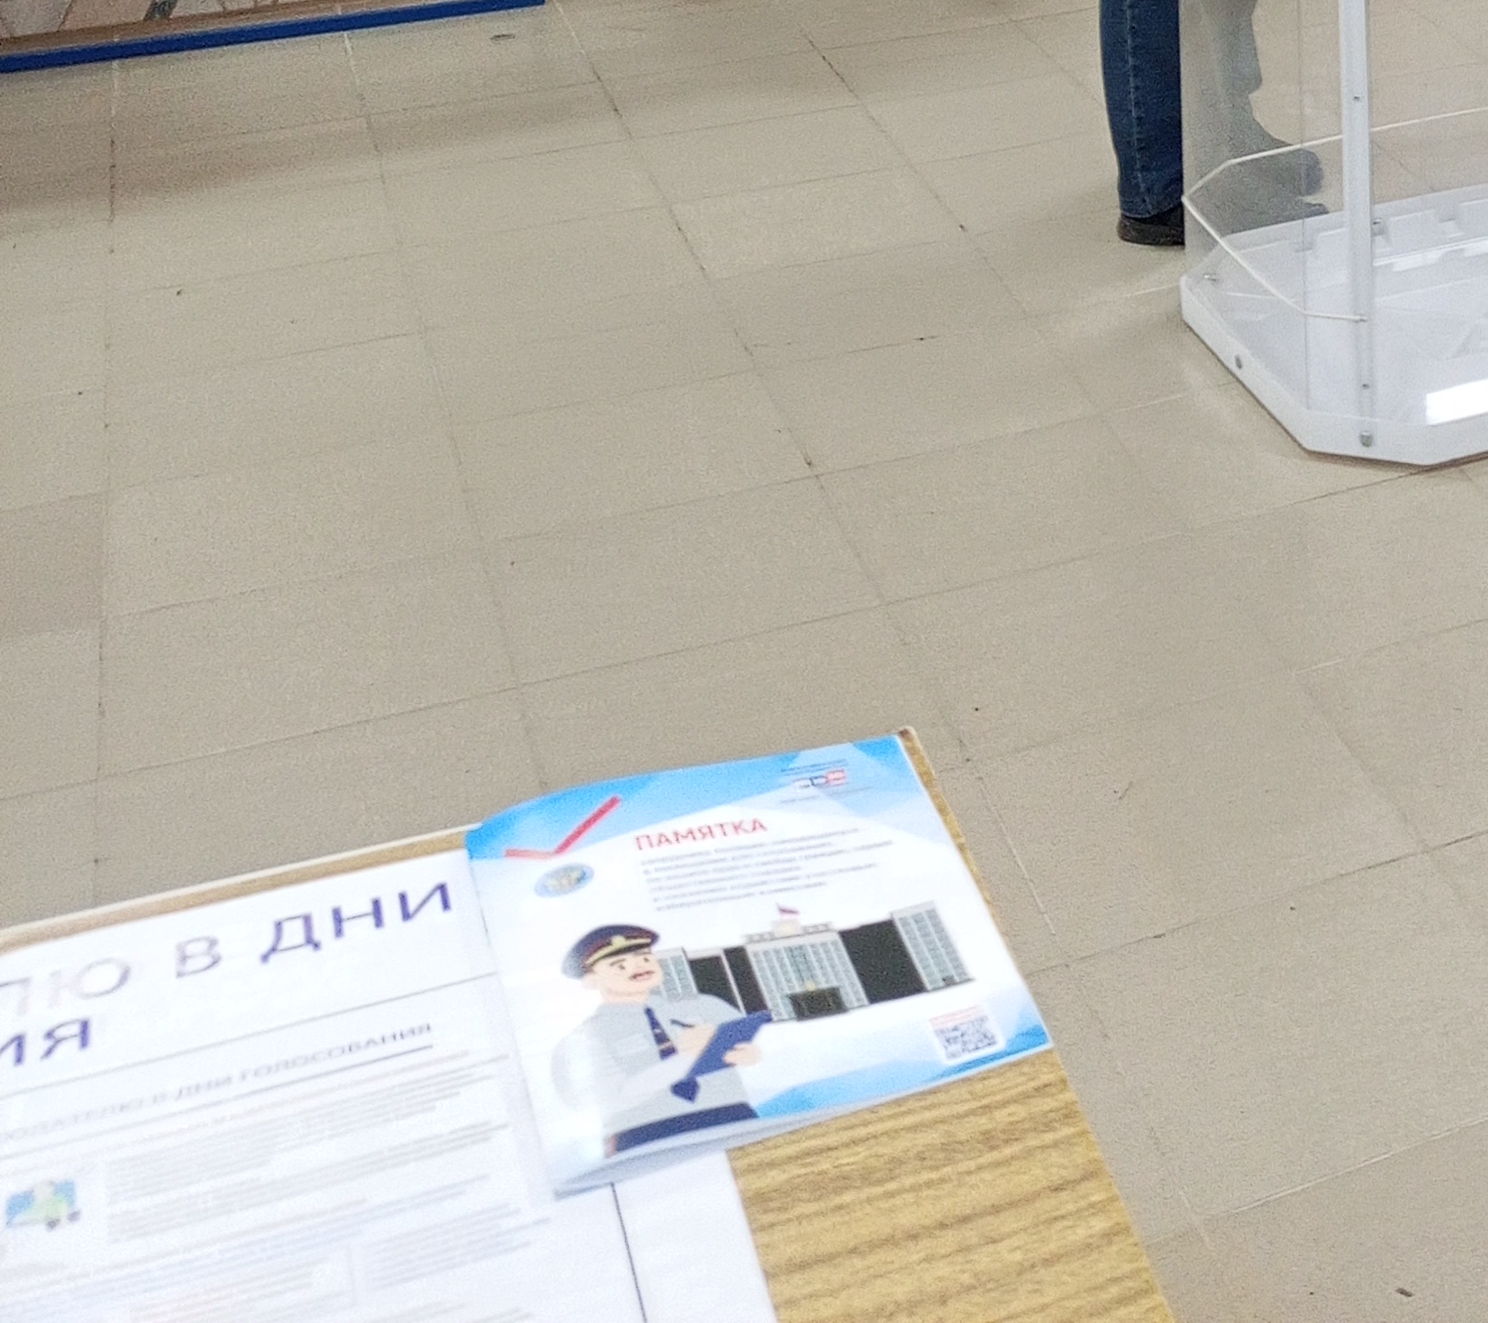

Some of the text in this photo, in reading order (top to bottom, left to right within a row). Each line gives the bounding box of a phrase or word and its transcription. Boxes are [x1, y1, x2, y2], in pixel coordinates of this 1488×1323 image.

[634, 817, 769, 852] ПАМЯТКА
[174, 934, 223, 980] В
[259, 880, 453, 965] ДНИ
[239, 1022, 433, 1086] ГОЛОСОВАНИЯ
